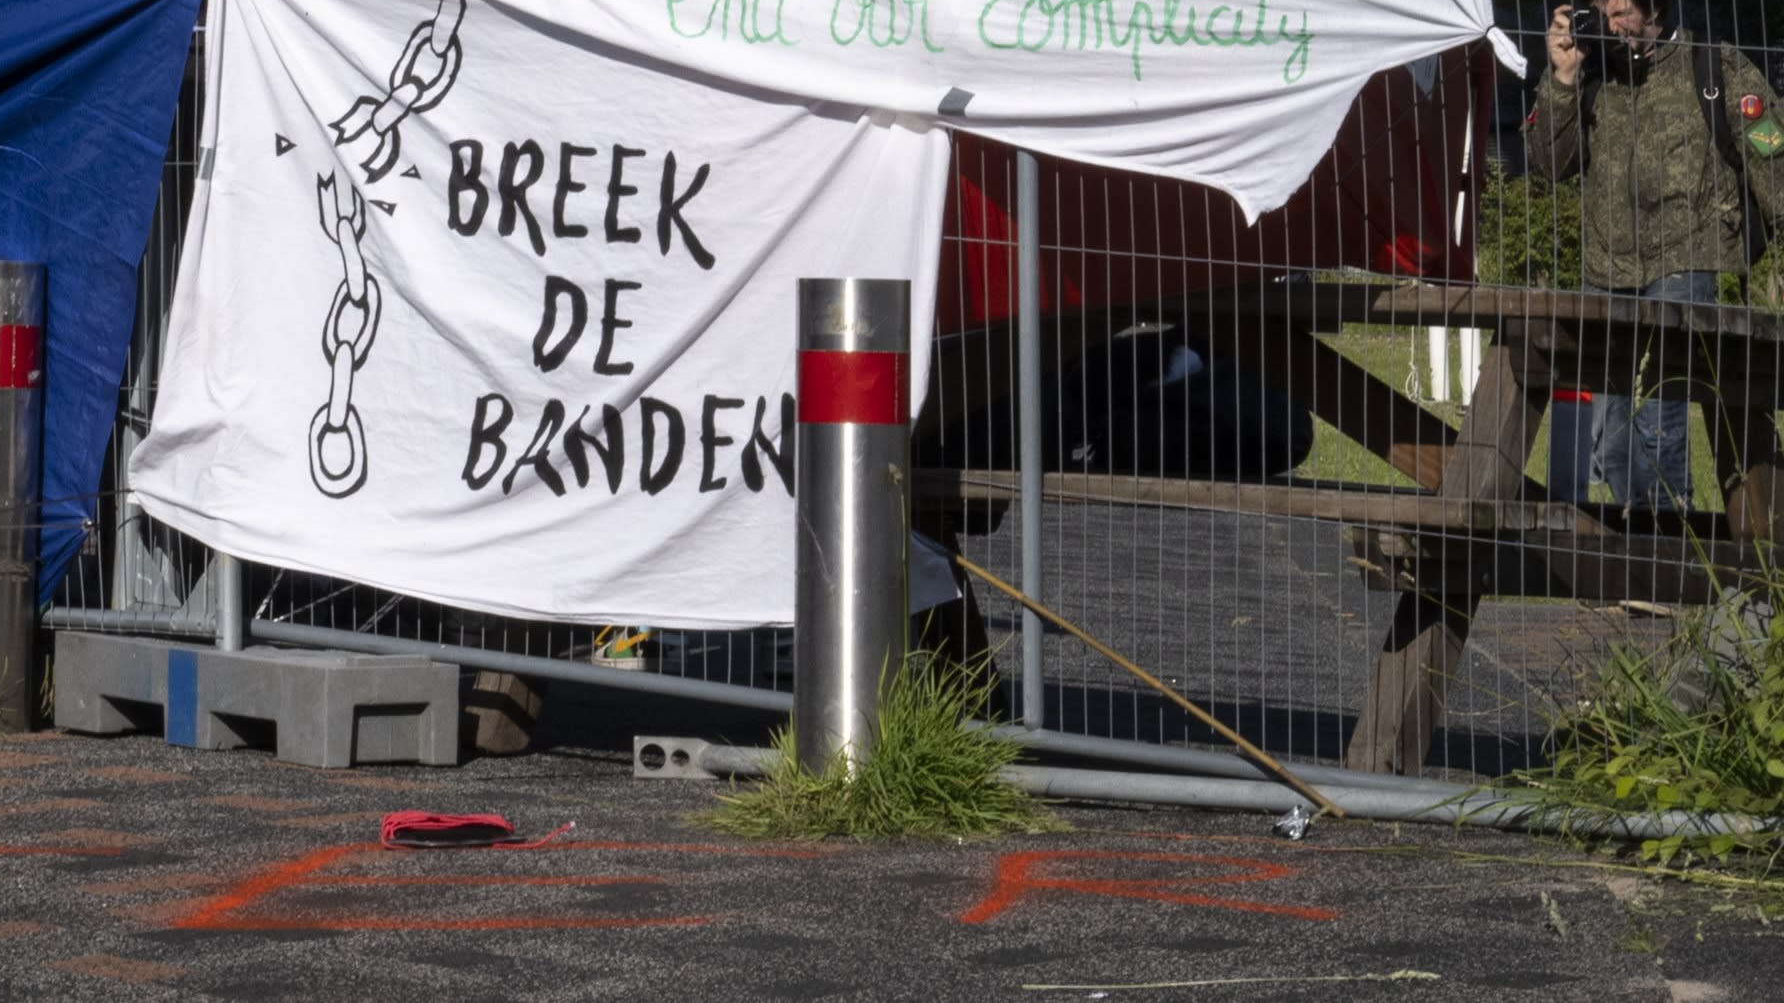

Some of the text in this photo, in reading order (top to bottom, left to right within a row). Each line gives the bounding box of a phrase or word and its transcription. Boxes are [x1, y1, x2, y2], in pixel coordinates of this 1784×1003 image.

[448, 139, 715, 270] BREEK
[533, 275, 642, 375] DE
[461, 392, 796, 496] BANDEN
